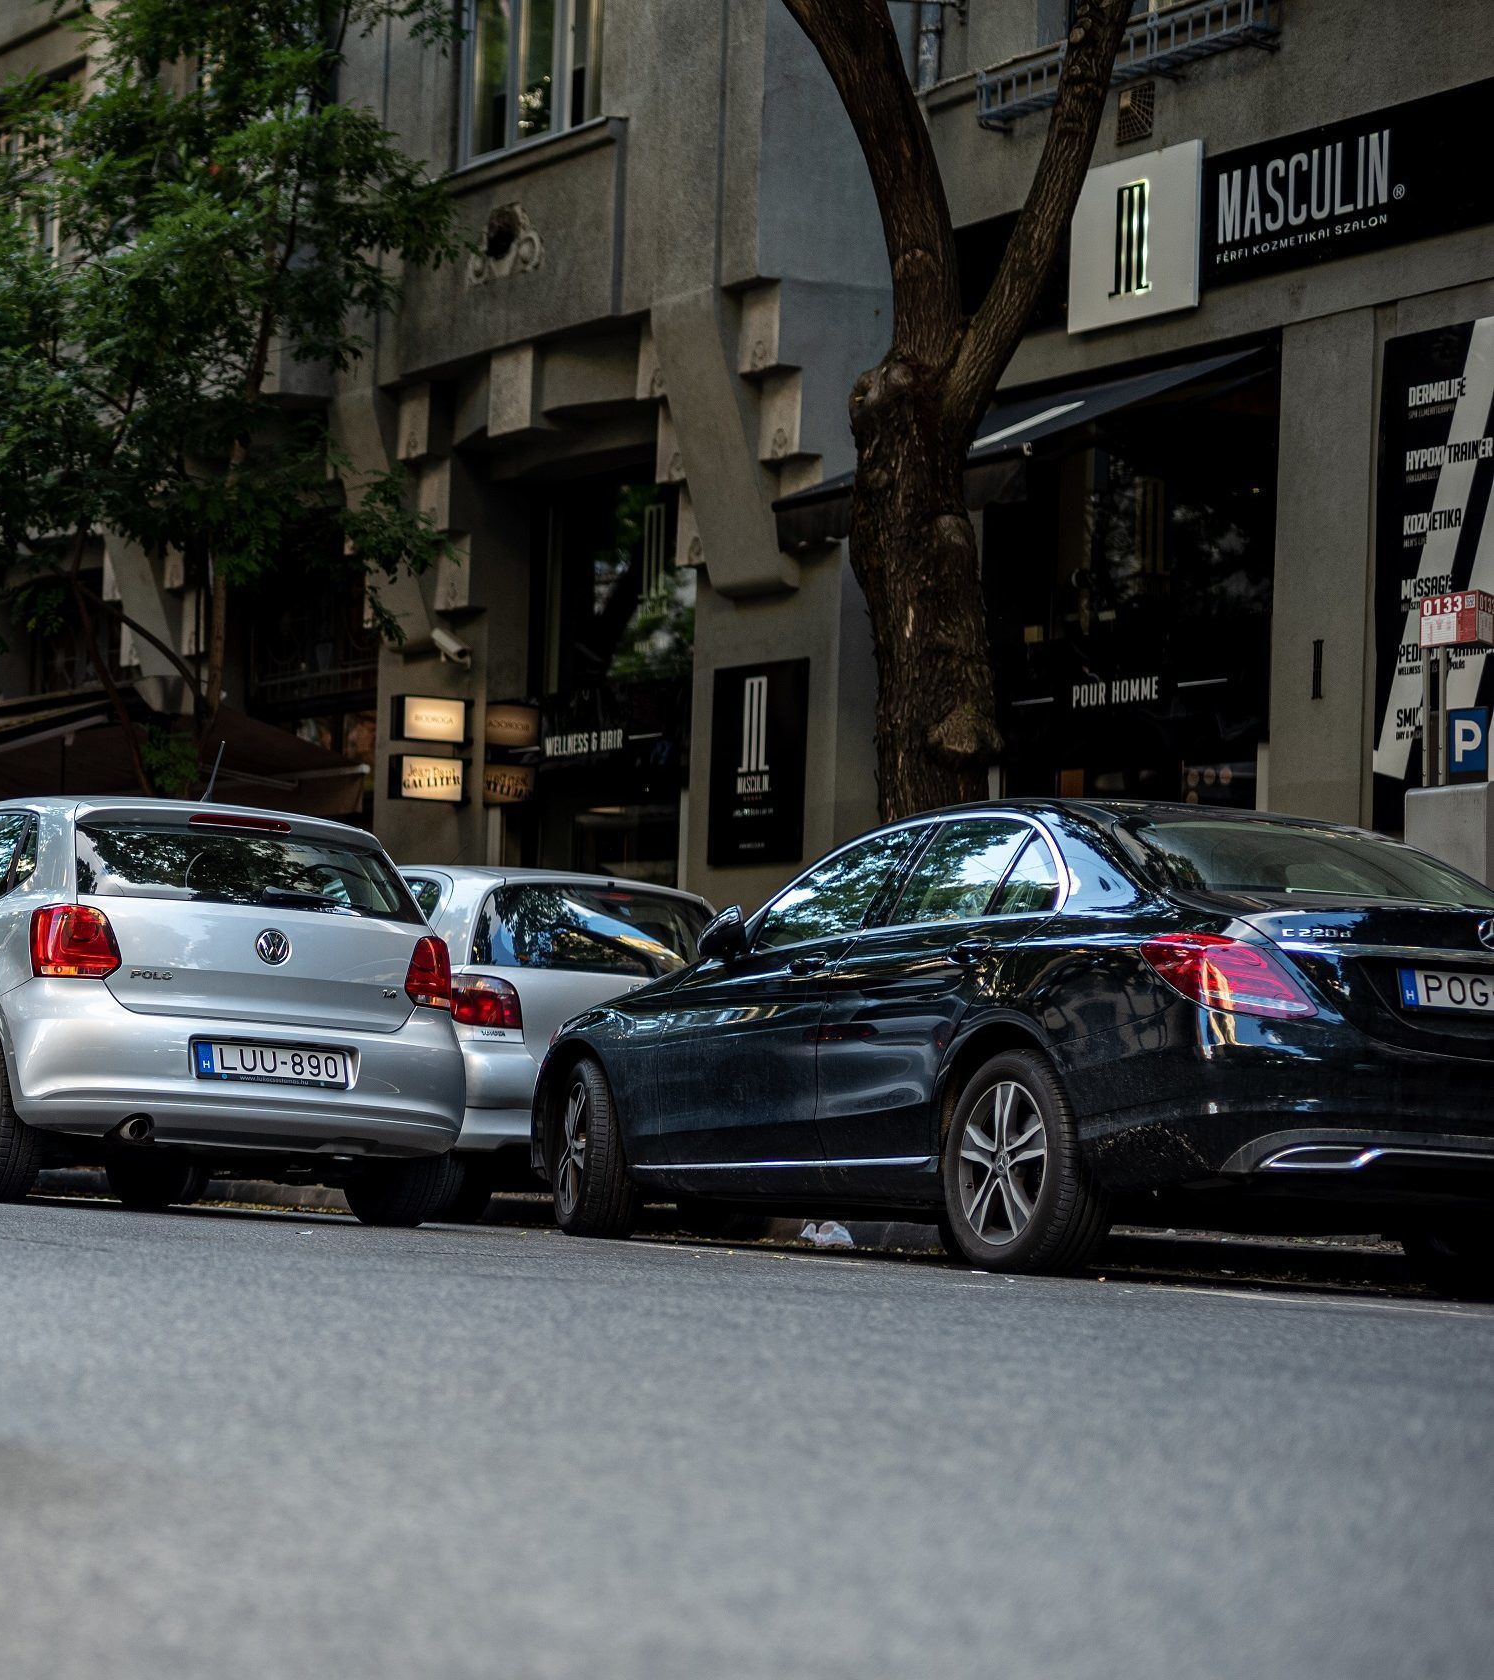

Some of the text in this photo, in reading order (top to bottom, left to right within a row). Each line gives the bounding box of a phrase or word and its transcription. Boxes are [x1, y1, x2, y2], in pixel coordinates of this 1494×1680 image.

[1216, 213, 1388, 265] FÉRFI KOZMETIKAI SZALON
[1408, 376, 1467, 408] DERMALIFE
[1403, 507, 1463, 536] KOZMETIKA
[1401, 574, 1452, 601] MASSAGE
[1423, 595, 1463, 616] 0133
[1398, 665, 1421, 676] WELLNESS
[1072, 676, 1159, 709] POUR HOMME
[545, 728, 623, 757] WELLNESS & HAIR
[1454, 719, 1482, 763] P
[403, 775, 461, 790] GAULTIER
[130, 969, 174, 981] POLO
[1406, 989, 1415, 1000] H
[203, 1047, 338, 1079] H LUU-890
